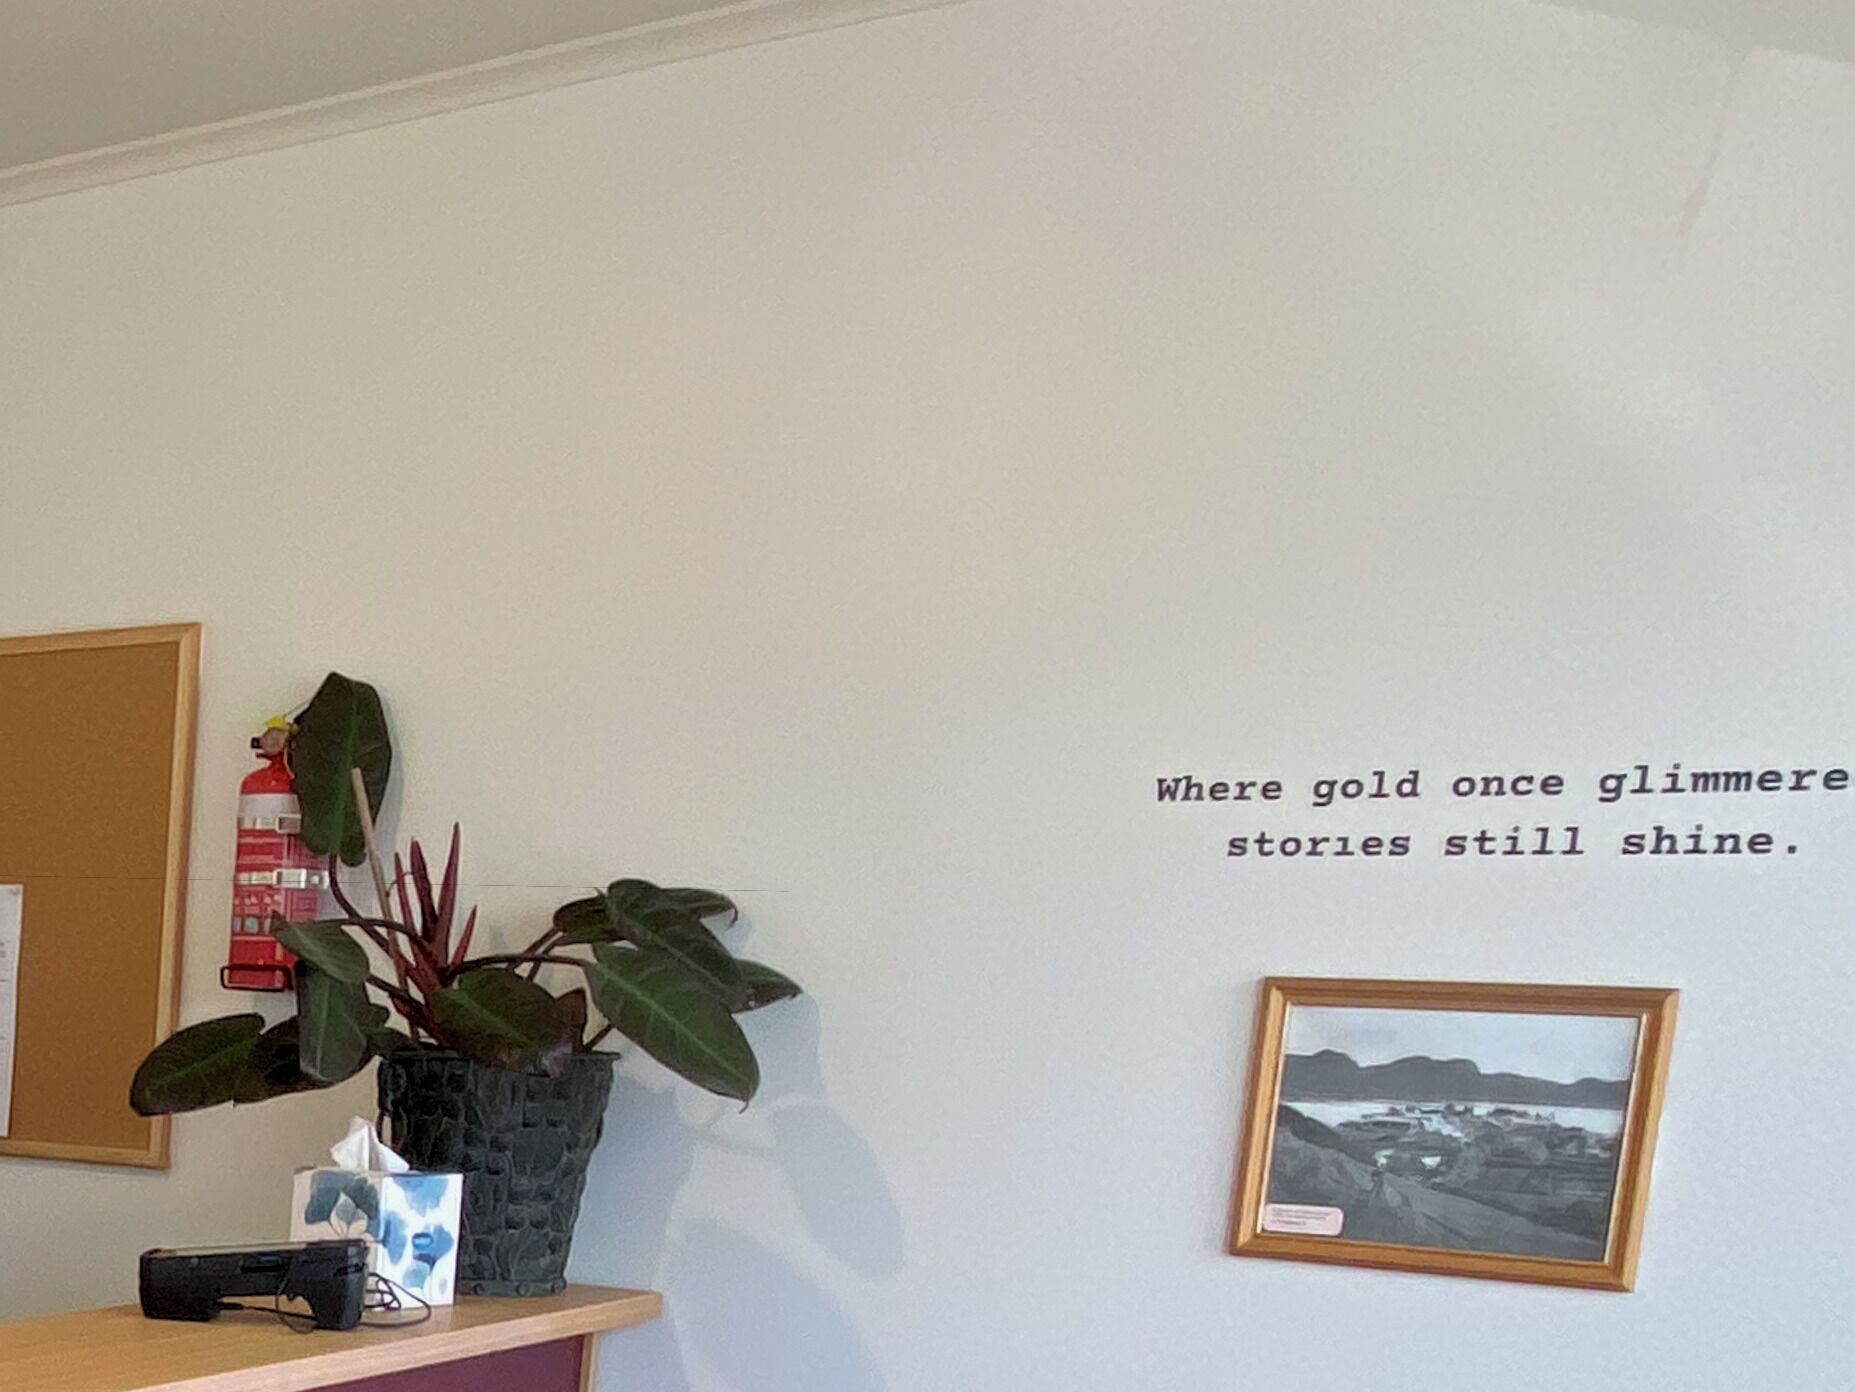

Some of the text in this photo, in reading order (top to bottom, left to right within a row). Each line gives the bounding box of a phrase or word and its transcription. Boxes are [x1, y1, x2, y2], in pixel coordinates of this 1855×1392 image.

[1156, 775, 1283, 802] Where
[1312, 770, 1422, 807] gold
[1452, 774, 1564, 797] once
[1444, 825, 1585, 856] still
[1621, 824, 1798, 855] shine.
